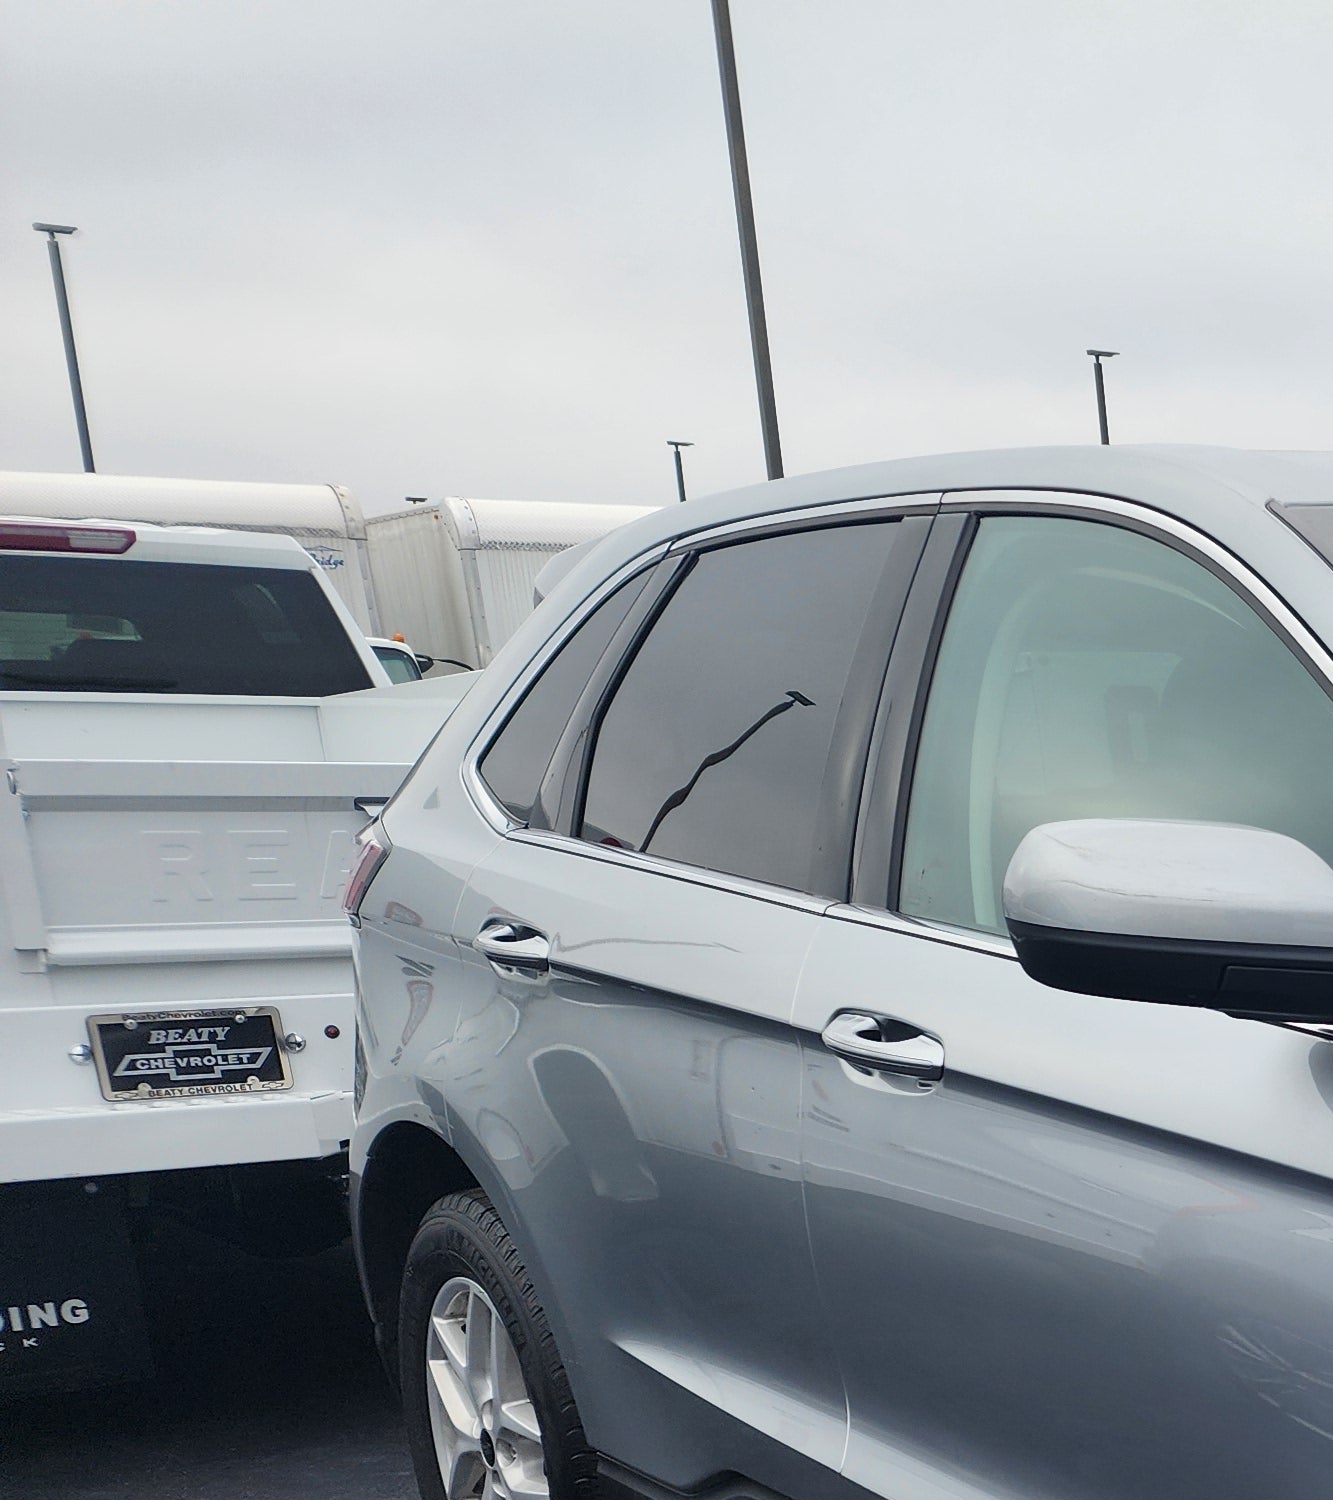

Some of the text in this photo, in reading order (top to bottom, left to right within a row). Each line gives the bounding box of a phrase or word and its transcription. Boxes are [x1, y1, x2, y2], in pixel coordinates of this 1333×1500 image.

[147, 1026, 231, 1045] BEATY
[135, 1053, 251, 1071] CHEVROLET
[148, 1083, 253, 1098] BEATY CHEVROLET
[0, 1298, 90, 1333] ING
